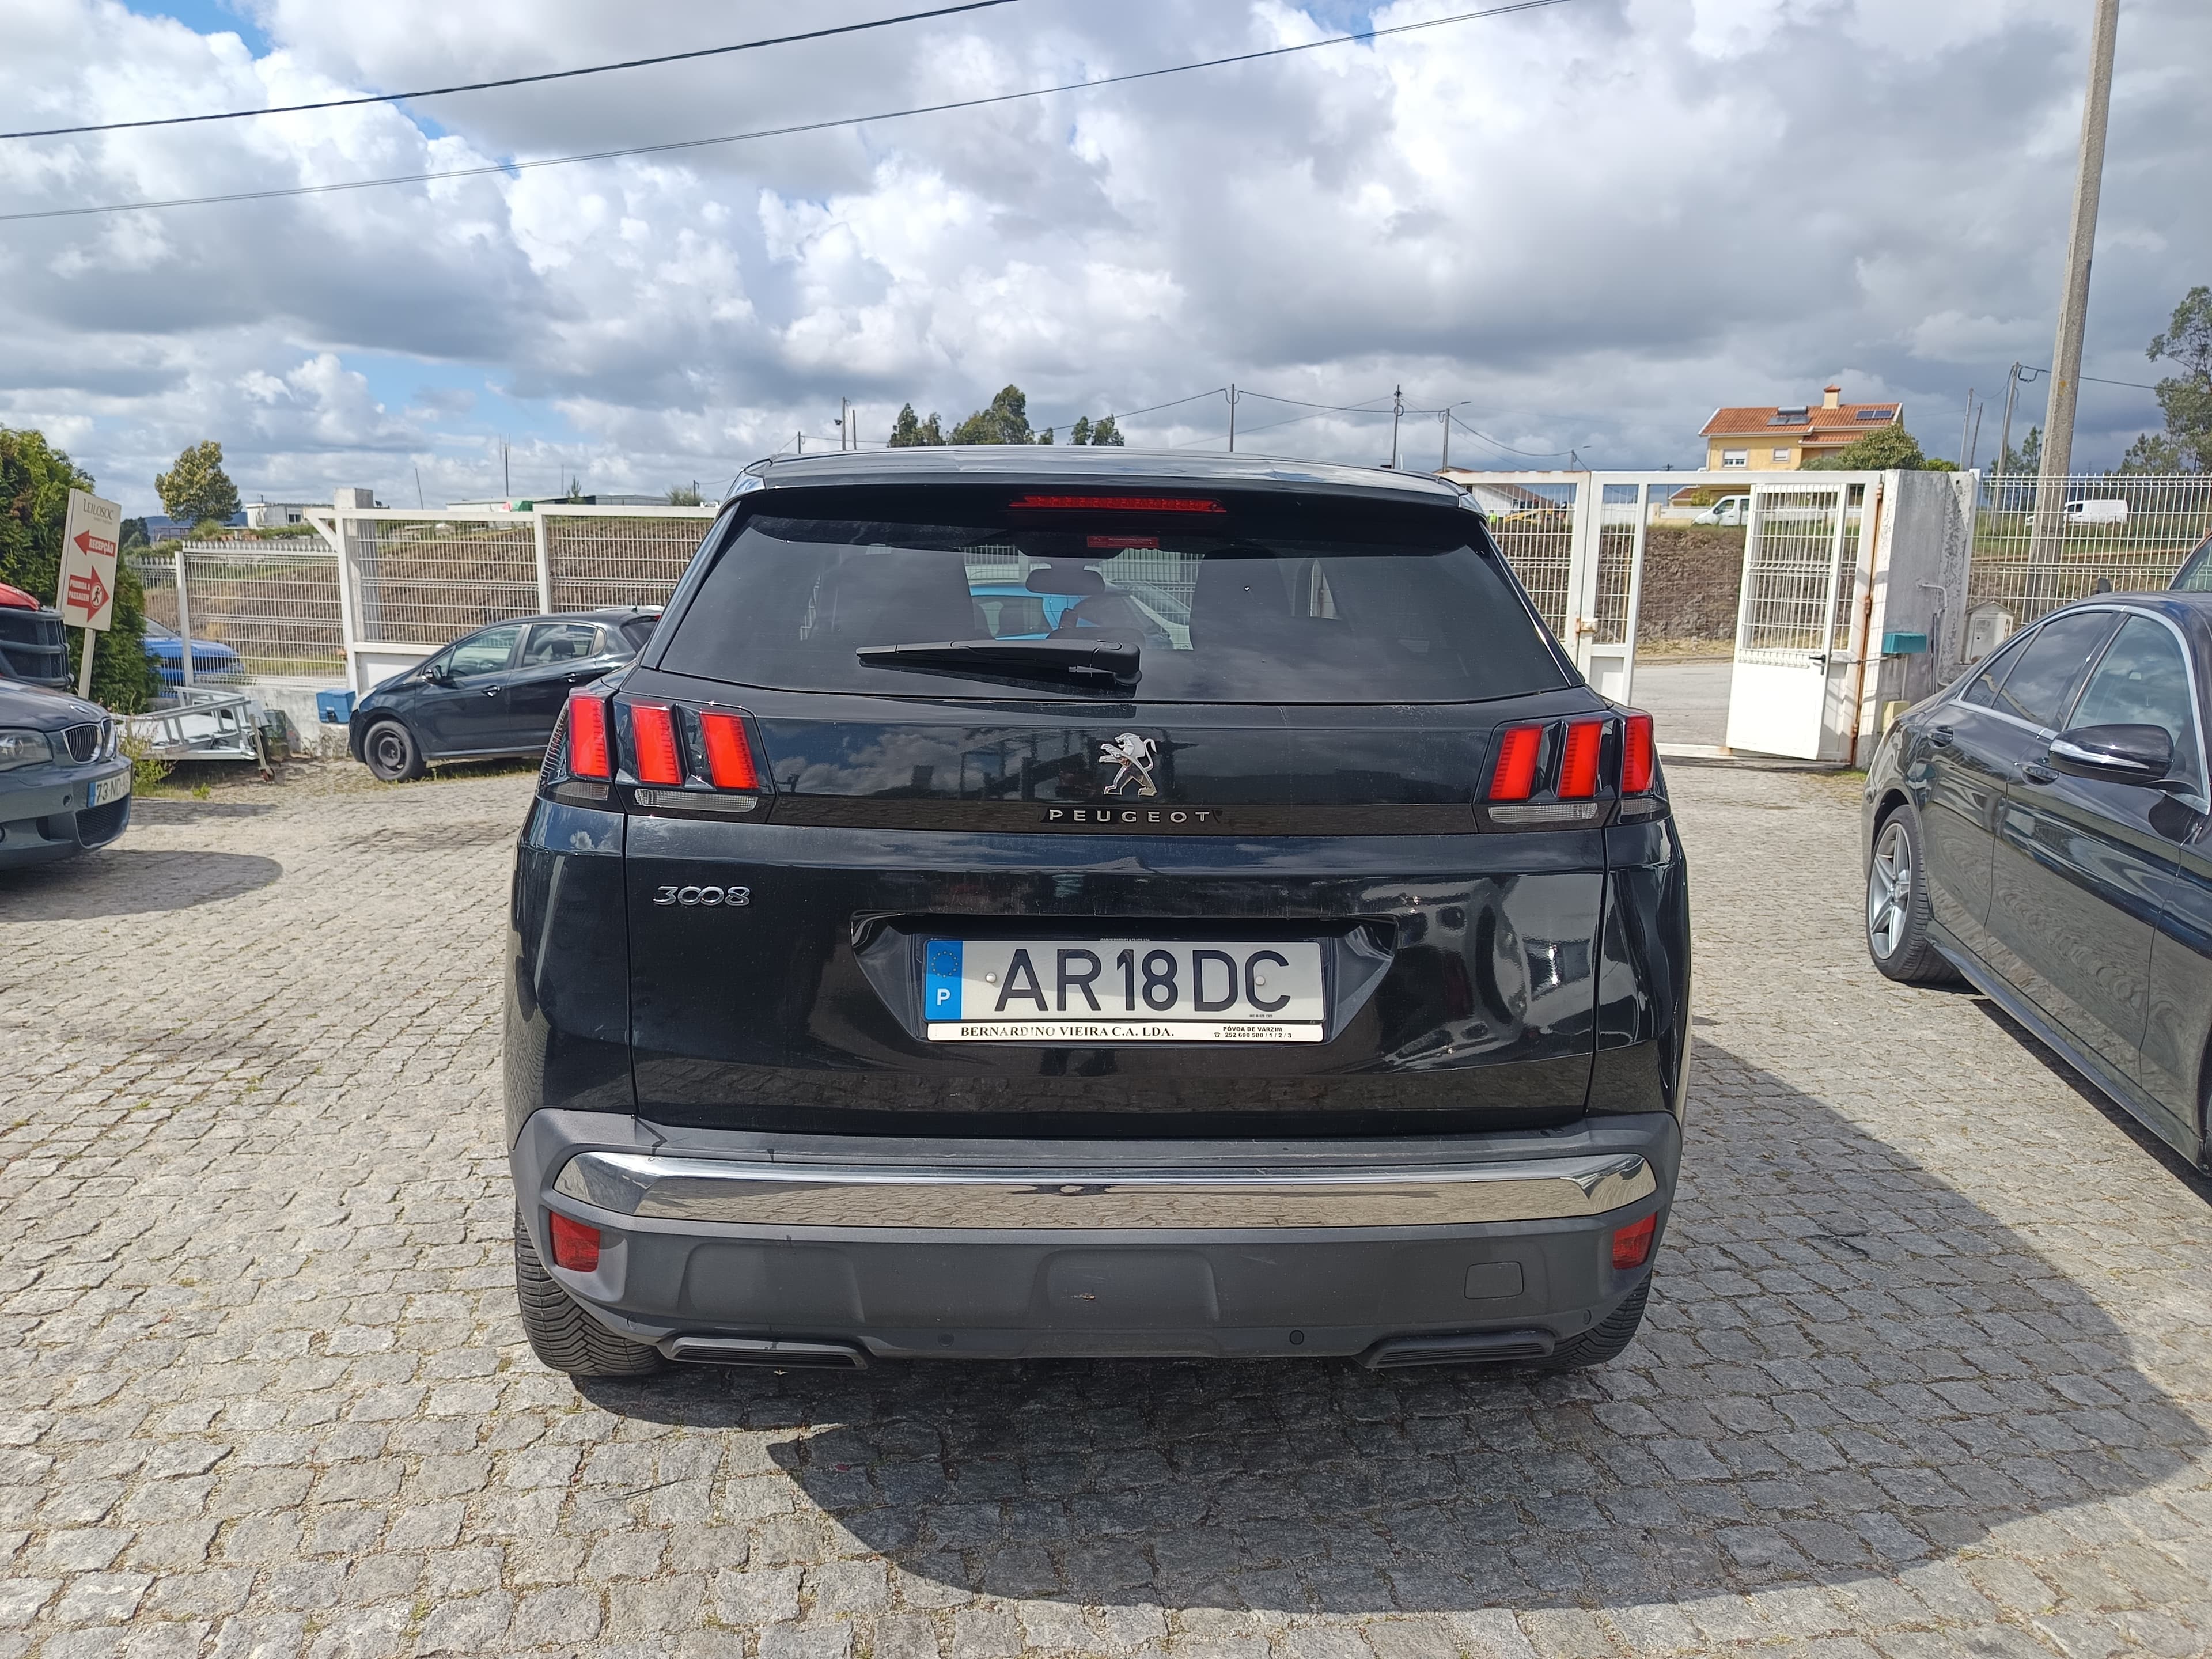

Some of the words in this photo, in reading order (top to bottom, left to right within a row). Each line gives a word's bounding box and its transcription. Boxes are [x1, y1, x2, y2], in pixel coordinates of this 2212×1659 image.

[83, 498, 112, 520] LEILOSOC
[89, 538, 114, 554] RECEPÇÃO
[1048, 809, 1210, 823] PEUGEOT
[653, 885, 751, 906] 3008
[937, 988, 950, 1006] P
[961, 1027, 1055, 1037] BERNARDINO
[1060, 1027, 1108, 1036] VIEIRA
[1112, 1027, 1138, 1036] C.A.
[1142, 1027, 1175, 1037] LDA.
